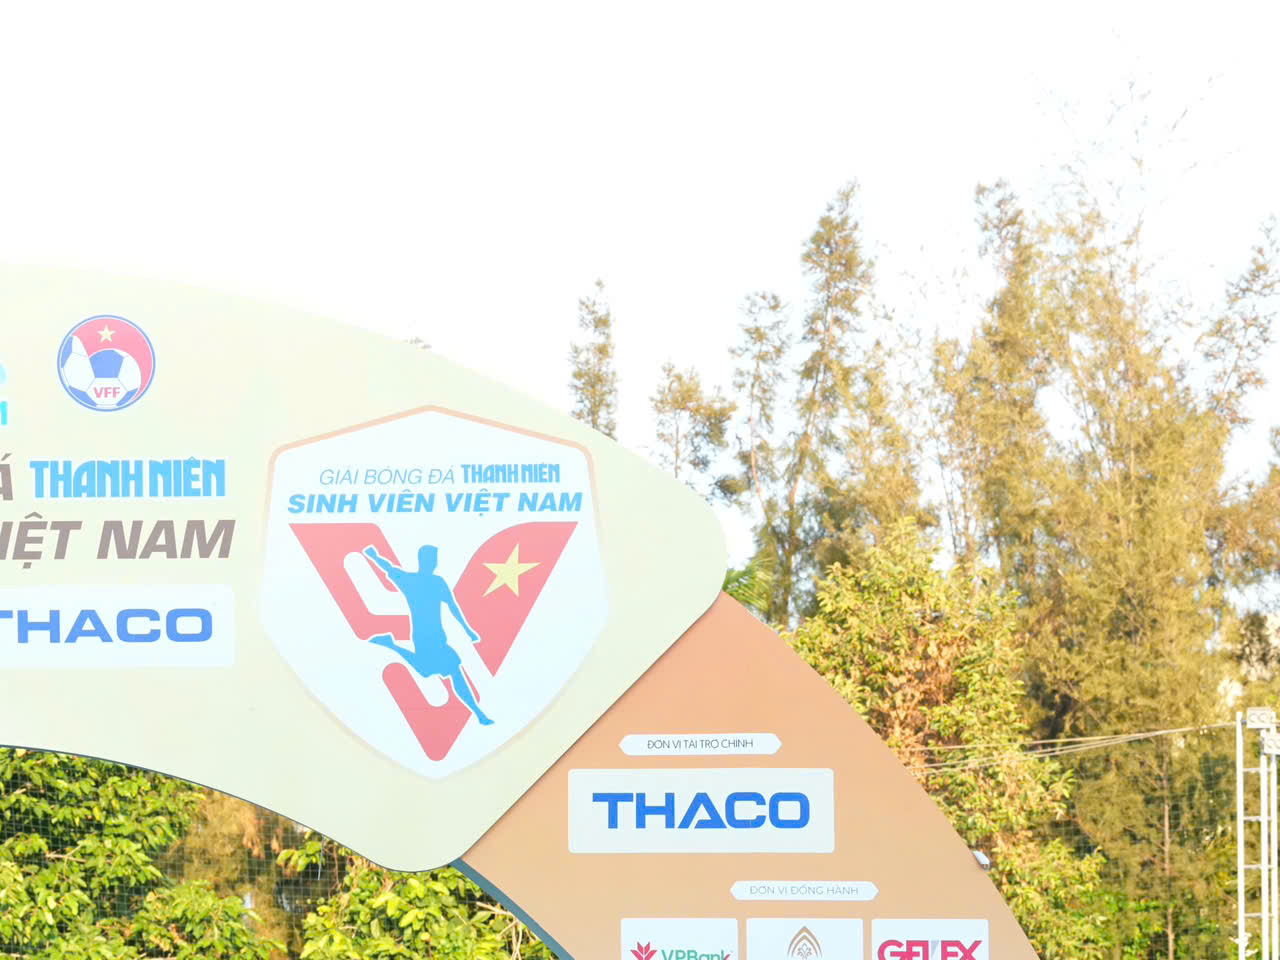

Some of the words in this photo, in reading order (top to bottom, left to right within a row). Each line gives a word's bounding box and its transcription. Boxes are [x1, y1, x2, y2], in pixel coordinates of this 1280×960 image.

[93, 386, 120, 399] VFF
[29, 459, 143, 499] THANH
[148, 456, 226, 498] NIÊN
[427, 465, 455, 485] ĐÁ
[461, 463, 518, 483] THANH
[287, 494, 358, 513] SINH
[368, 488, 435, 513] VIÊN
[444, 488, 510, 517] VIỆT
[517, 492, 583, 512] NAM
[96, 519, 235, 559] NAM
[592, 792, 810, 829] THACO
